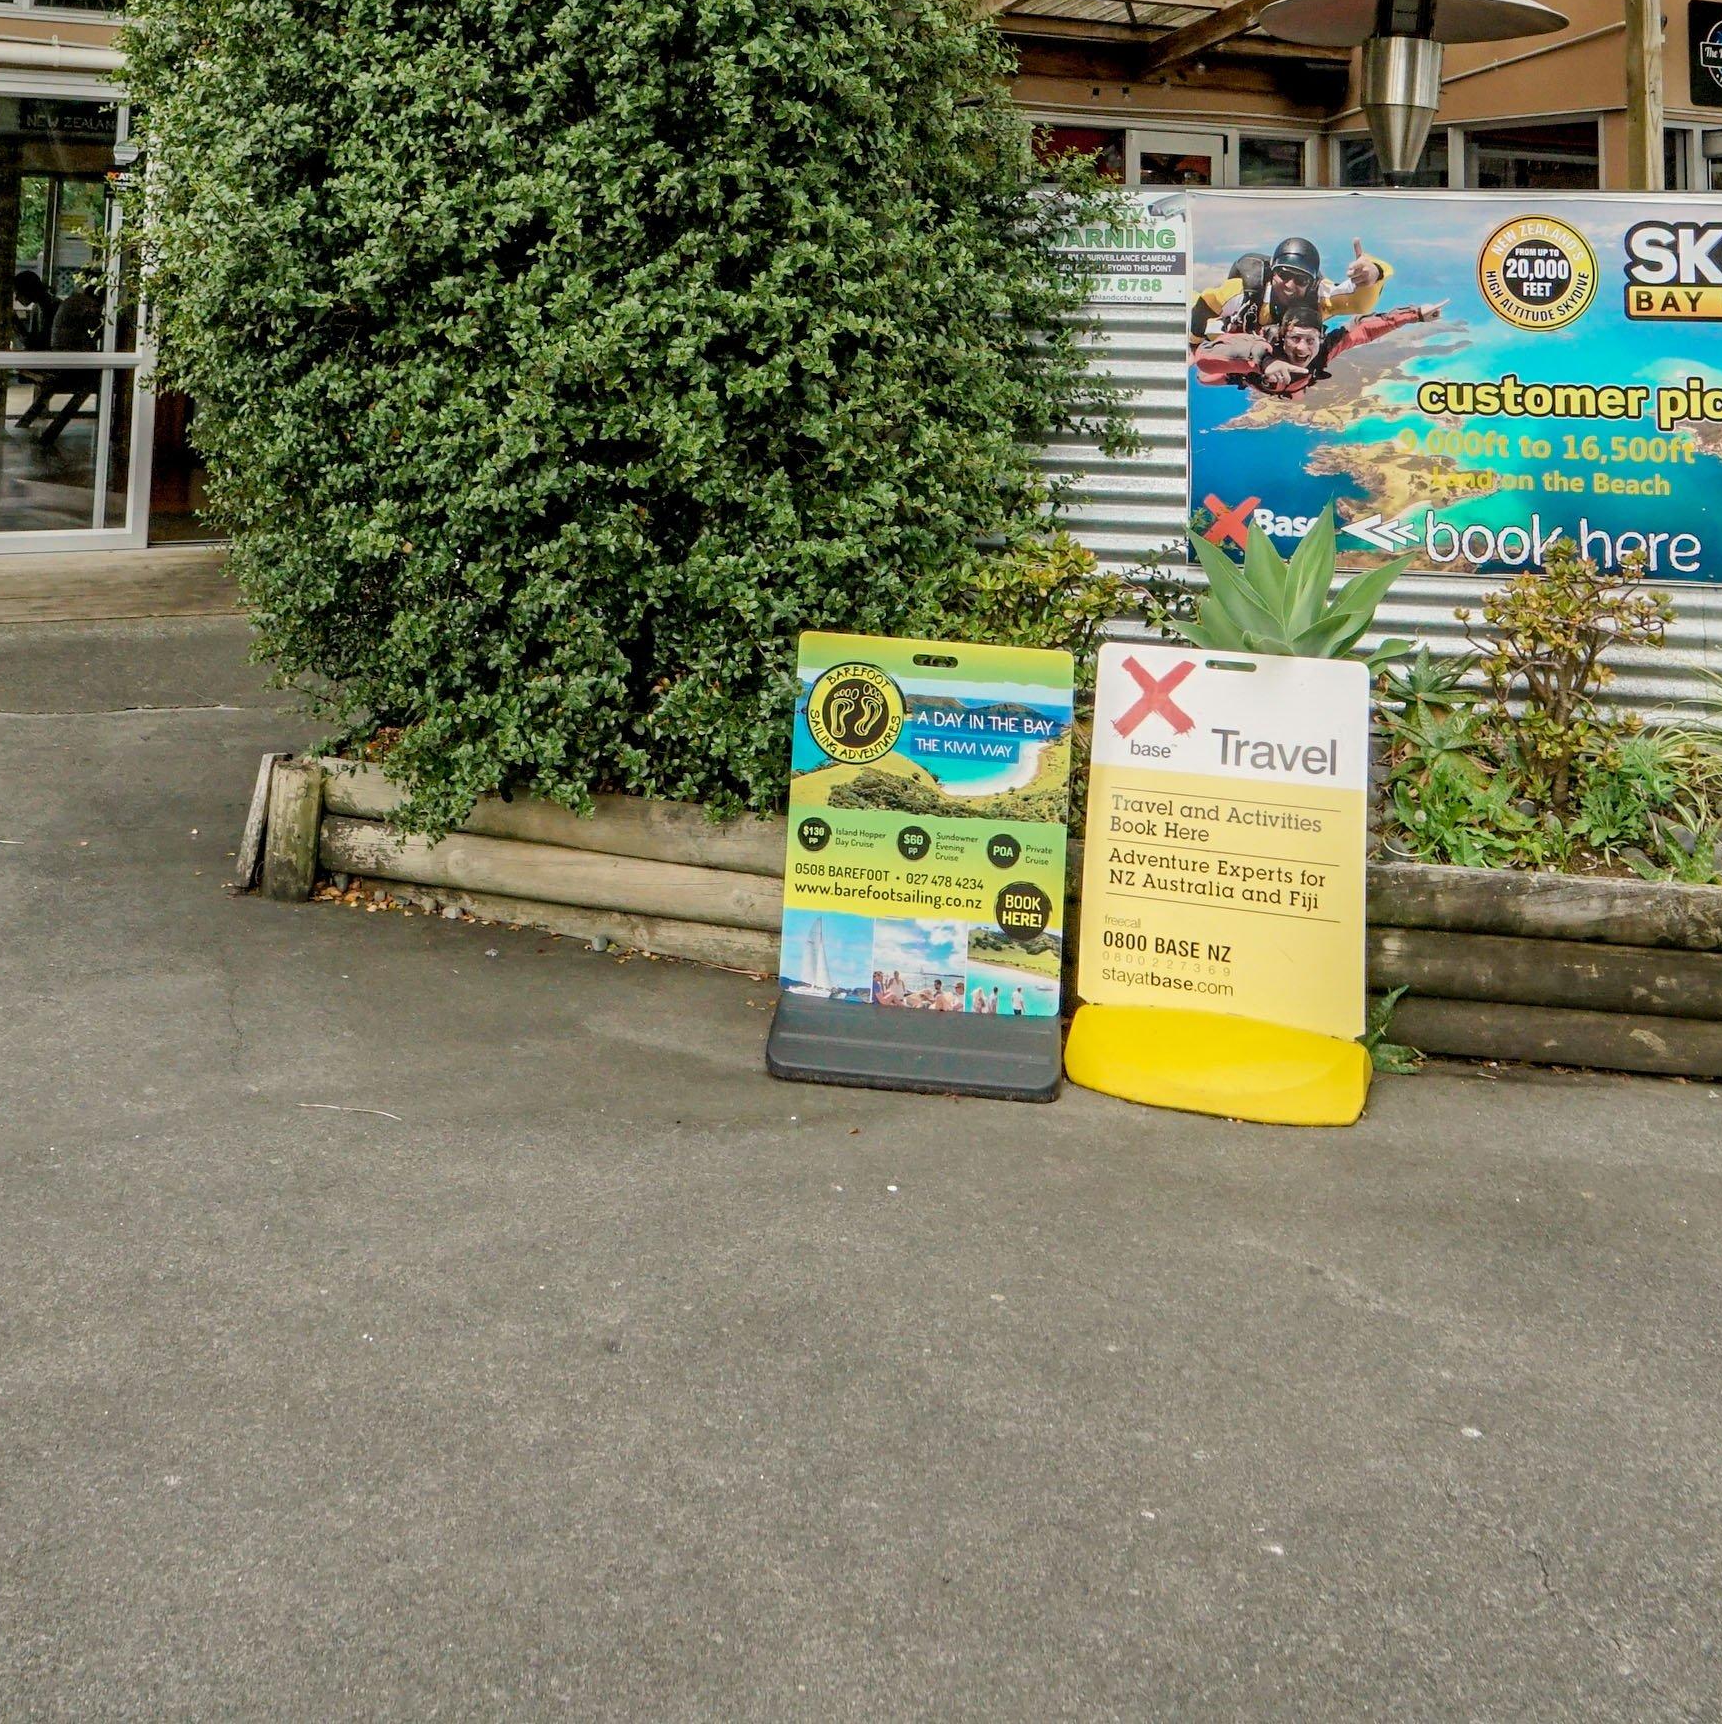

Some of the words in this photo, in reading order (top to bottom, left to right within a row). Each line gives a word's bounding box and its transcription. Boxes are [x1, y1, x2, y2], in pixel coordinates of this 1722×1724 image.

[1491, 229, 1517, 255] NEW
[1518, 223, 1583, 261] ZEALAND'S
[1087, 254, 1140, 262] SURVEILLANCE
[1141, 254, 1176, 262] CAMERAS
[1515, 248, 1537, 256] FROM
[1538, 248, 1549, 257] UP
[1549, 249, 1560, 257] TO
[1134, 264, 1150, 272] THIS
[1150, 264, 1173, 273] POINT
[1505, 258, 1569, 281] 20,000
[1117, 278, 1162, 292] 8788
[1523, 282, 1552, 297] FEET
[1485, 270, 1504, 299] HIGH
[1500, 298, 1555, 322] ALTITUDE
[1557, 271, 1589, 316] SKYDIVE
[1635, 291, 1704, 312] BAY
[1419, 375, 1648, 417] customer
[1519, 435, 1552, 459] to
[1563, 435, 1695, 464] 16,500ft
[1431, 467, 1494, 489] Land
[1502, 475, 1534, 491] on
[1542, 470, 1584, 492] the
[1593, 472, 1670, 496] Beach
[1426, 509, 1563, 566] book
[1579, 517, 1702, 572] here
[827, 666, 891, 689] BAREFOOT
[918, 711, 929, 725] A
[934, 712, 965, 728] DAY
[969, 715, 984, 730] IN
[988, 716, 1019, 733] THE
[1023, 719, 1054, 736] BAY
[810, 709, 837, 755] SAILING
[839, 715, 901, 759] ADVENTURES
[915, 738, 938, 752] THE
[944, 740, 977, 755] KIWI
[980, 743, 1013, 758] WAY
[1130, 739, 1171, 759] base
[1211, 728, 1337, 776] Travel
[1112, 794, 1174, 817] Travel
[1180, 804, 1220, 822] and
[1227, 807, 1323, 833] Activities
[803, 825, 825, 837] $130
[835, 827, 858, 838] Island
[859, 829, 886, 840] Hopper
[936, 832, 979, 844] Sundowner
[1110, 815, 1157, 837] Book
[1164, 822, 1210, 842] Here
[835, 837, 850, 847] Day
[850, 839, 875, 848] Cruise
[903, 834, 924, 846] $60
[935, 843, 964, 854] Evening
[1026, 845, 1053, 855] Private
[935, 852, 959, 862] Cruise
[993, 845, 1014, 858] POA
[1025, 855, 1049, 866] Cruise
[795, 862, 825, 876] 0508
[828, 865, 890, 882] BAREFOOT
[906, 873, 928, 885] 027
[931, 874, 952, 888] 478
[955, 876, 984, 890] 4234
[1108, 847, 1210, 874] Adventure
[1217, 860, 1293, 884] Experts
[1300, 869, 1326, 888] for
[795, 880, 983, 910] www.barefootsailing.co.nz
[1109, 869, 1135, 887] NZ
[1142, 873, 1235, 899] Australia
[1242, 887, 1281, 905] and
[1289, 890, 1319, 912] Fiji
[1005, 894, 1041, 911] BOOK
[1002, 911, 1043, 928] HERE!
[1104, 914, 1141, 928] freecall
[1103, 930, 1147, 951] 0800
[1155, 937, 1200, 959] BASE
[1208, 944, 1232, 963] NZ
[1102, 966, 1234, 997] stayatbase.com
